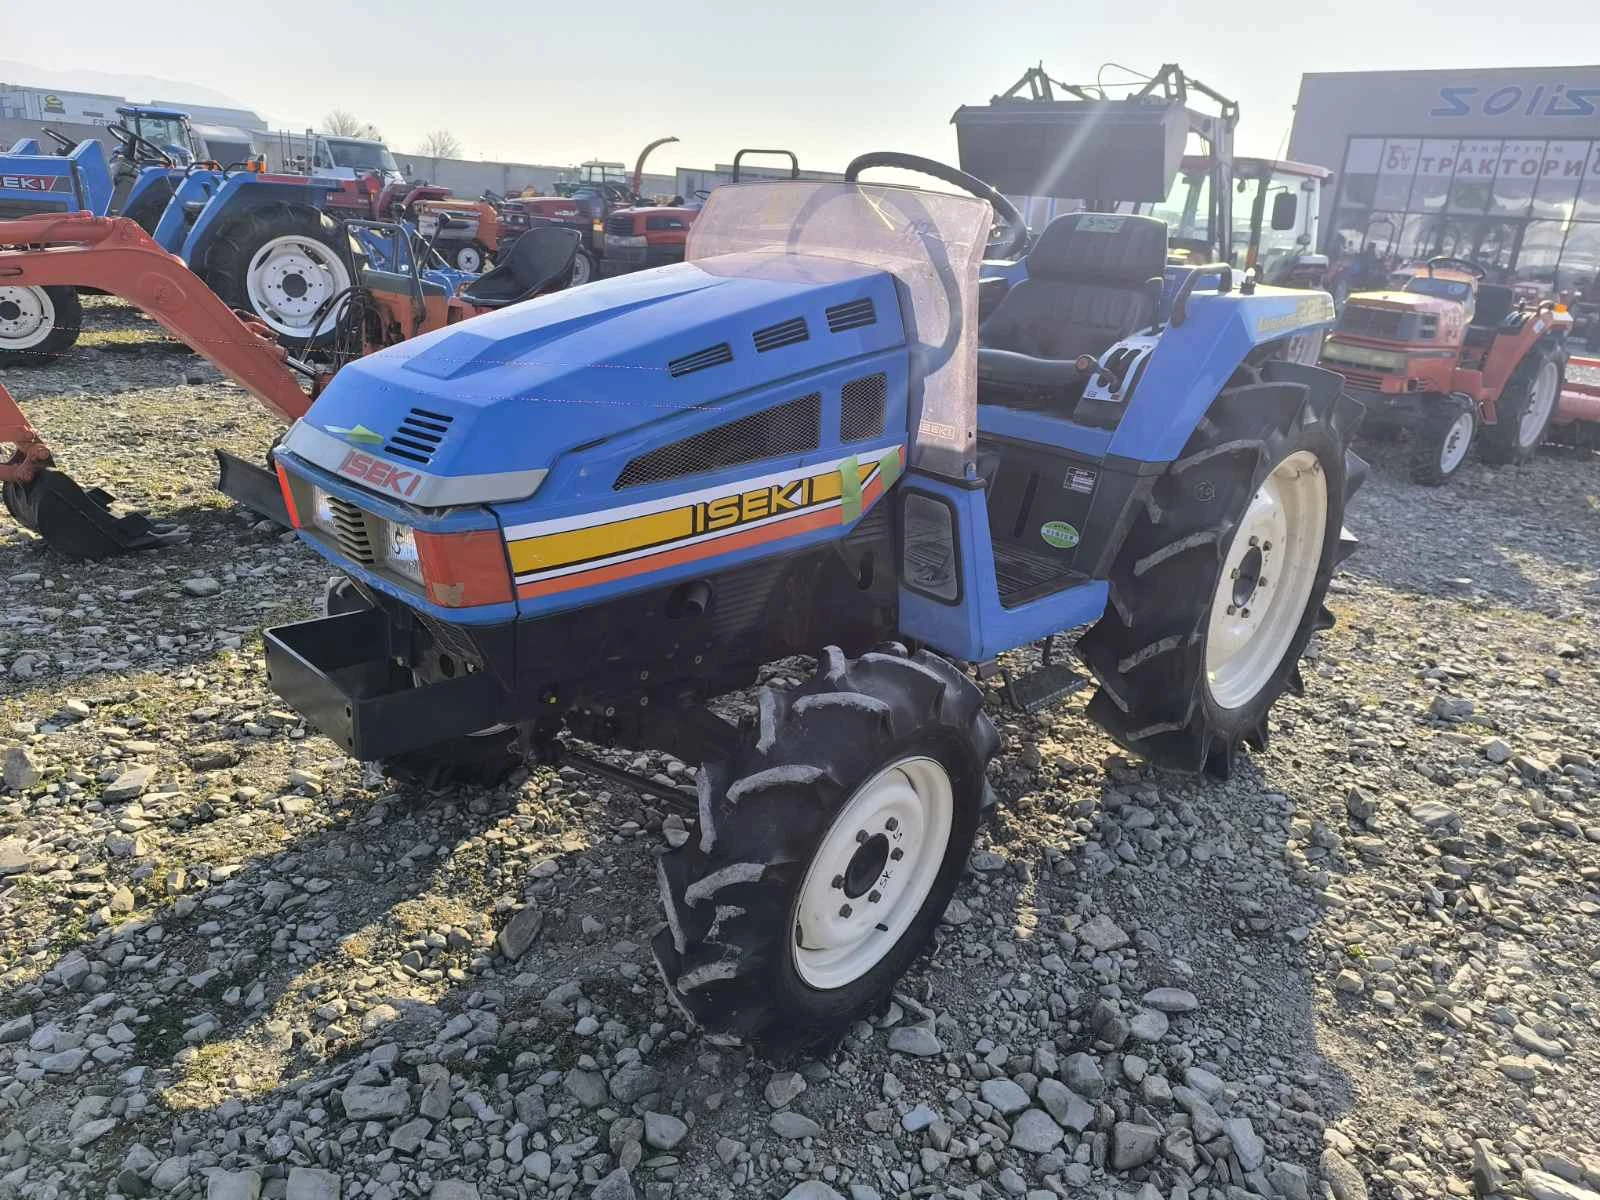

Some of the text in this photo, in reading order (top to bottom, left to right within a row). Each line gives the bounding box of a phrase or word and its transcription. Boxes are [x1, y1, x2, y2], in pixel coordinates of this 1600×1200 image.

[0, 175, 45, 190] EKI
[1421, 157, 1583, 176] ТРАКТОРИ
[341, 450, 422, 497] ISEKI
[695, 477, 811, 534] ISEKI
